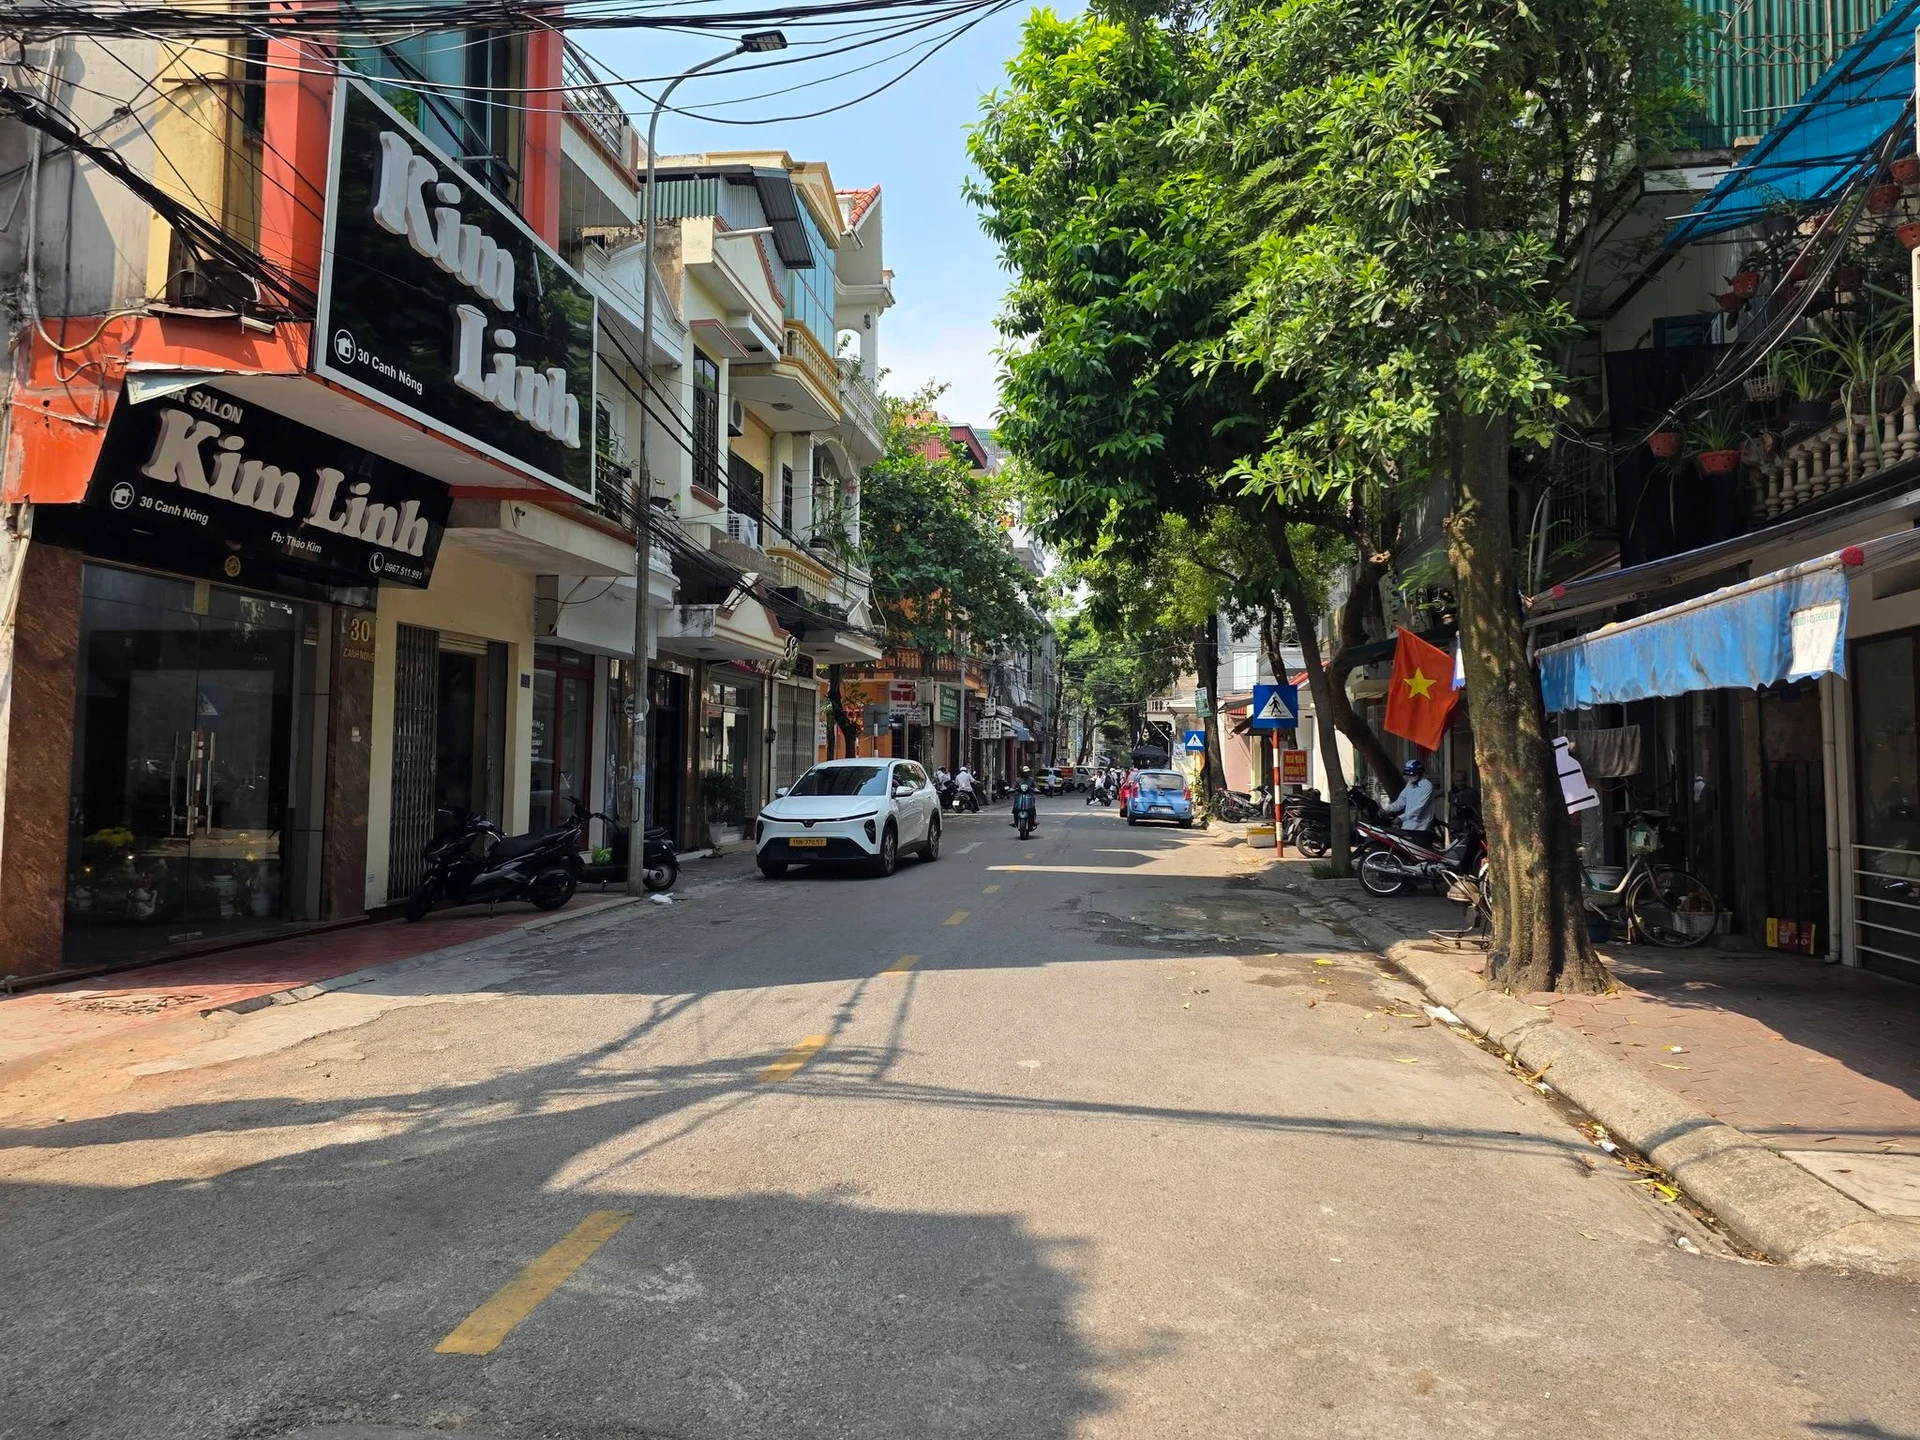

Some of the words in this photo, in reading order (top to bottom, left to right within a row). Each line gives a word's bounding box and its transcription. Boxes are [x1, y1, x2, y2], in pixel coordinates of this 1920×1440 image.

[373, 131, 515, 312] Kim
[357, 348, 369, 365] 30
[371, 356, 396, 379] Canh
[398, 369, 423, 395] Nông
[454, 304, 581, 449] Linh
[189, 391, 244, 424] SALON
[142, 408, 300, 518] Kim
[303, 467, 429, 557] Linh
[139, 496, 153, 508] 30
[154, 500, 181, 517] Canh
[182, 507, 209, 525] Nông
[270, 531, 285, 544] Fb:
[306, 541, 322, 553] Kim
[384, 562, 423, 580] 0967.511.991
[351, 618, 370, 642] 30
